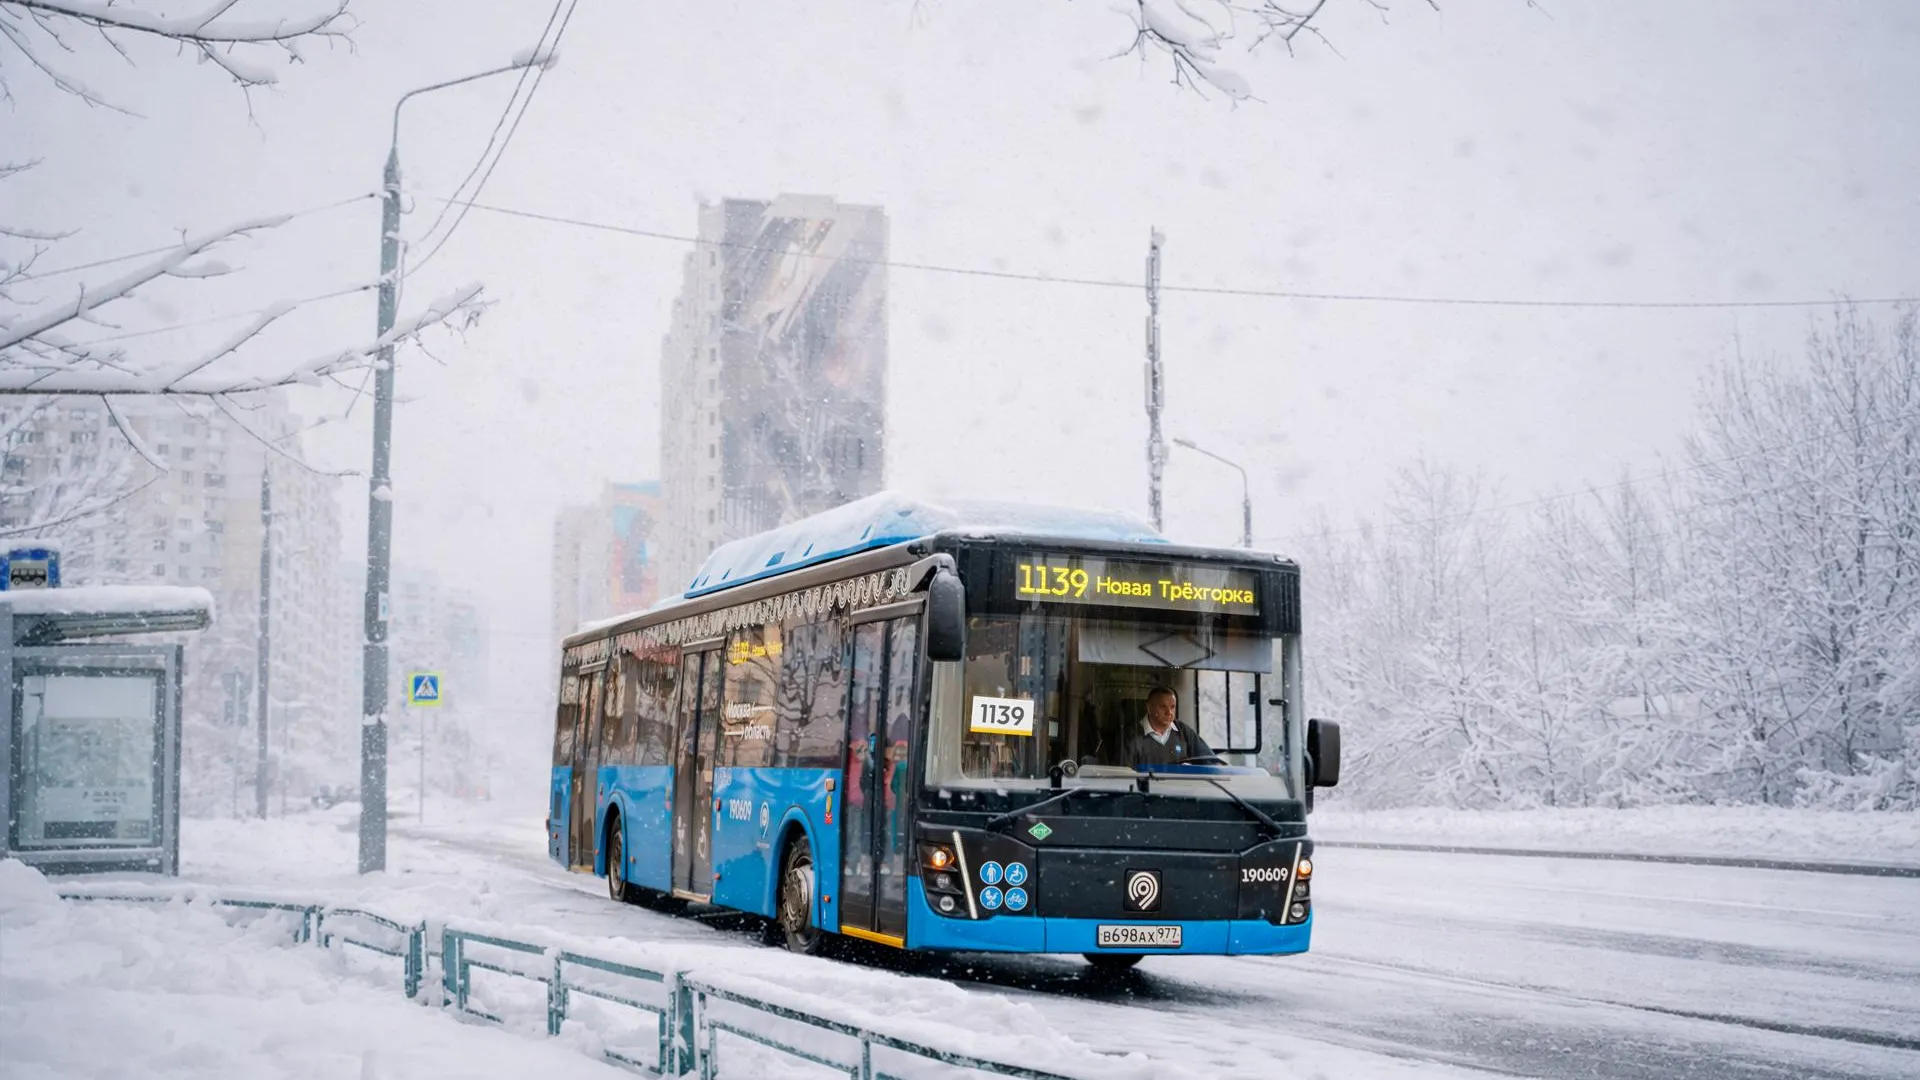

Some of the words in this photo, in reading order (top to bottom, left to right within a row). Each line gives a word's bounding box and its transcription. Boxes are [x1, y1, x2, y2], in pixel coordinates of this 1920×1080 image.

[1020, 565, 1089, 598] 1139
[1096, 575, 1152, 597] Новая
[1158, 580, 1254, 605] Трёхгорка
[980, 703, 1025, 726] 1139
[729, 798, 752, 820] 190609
[1241, 867, 1289, 882] 190609
[1157, 927, 1177, 939] 977
